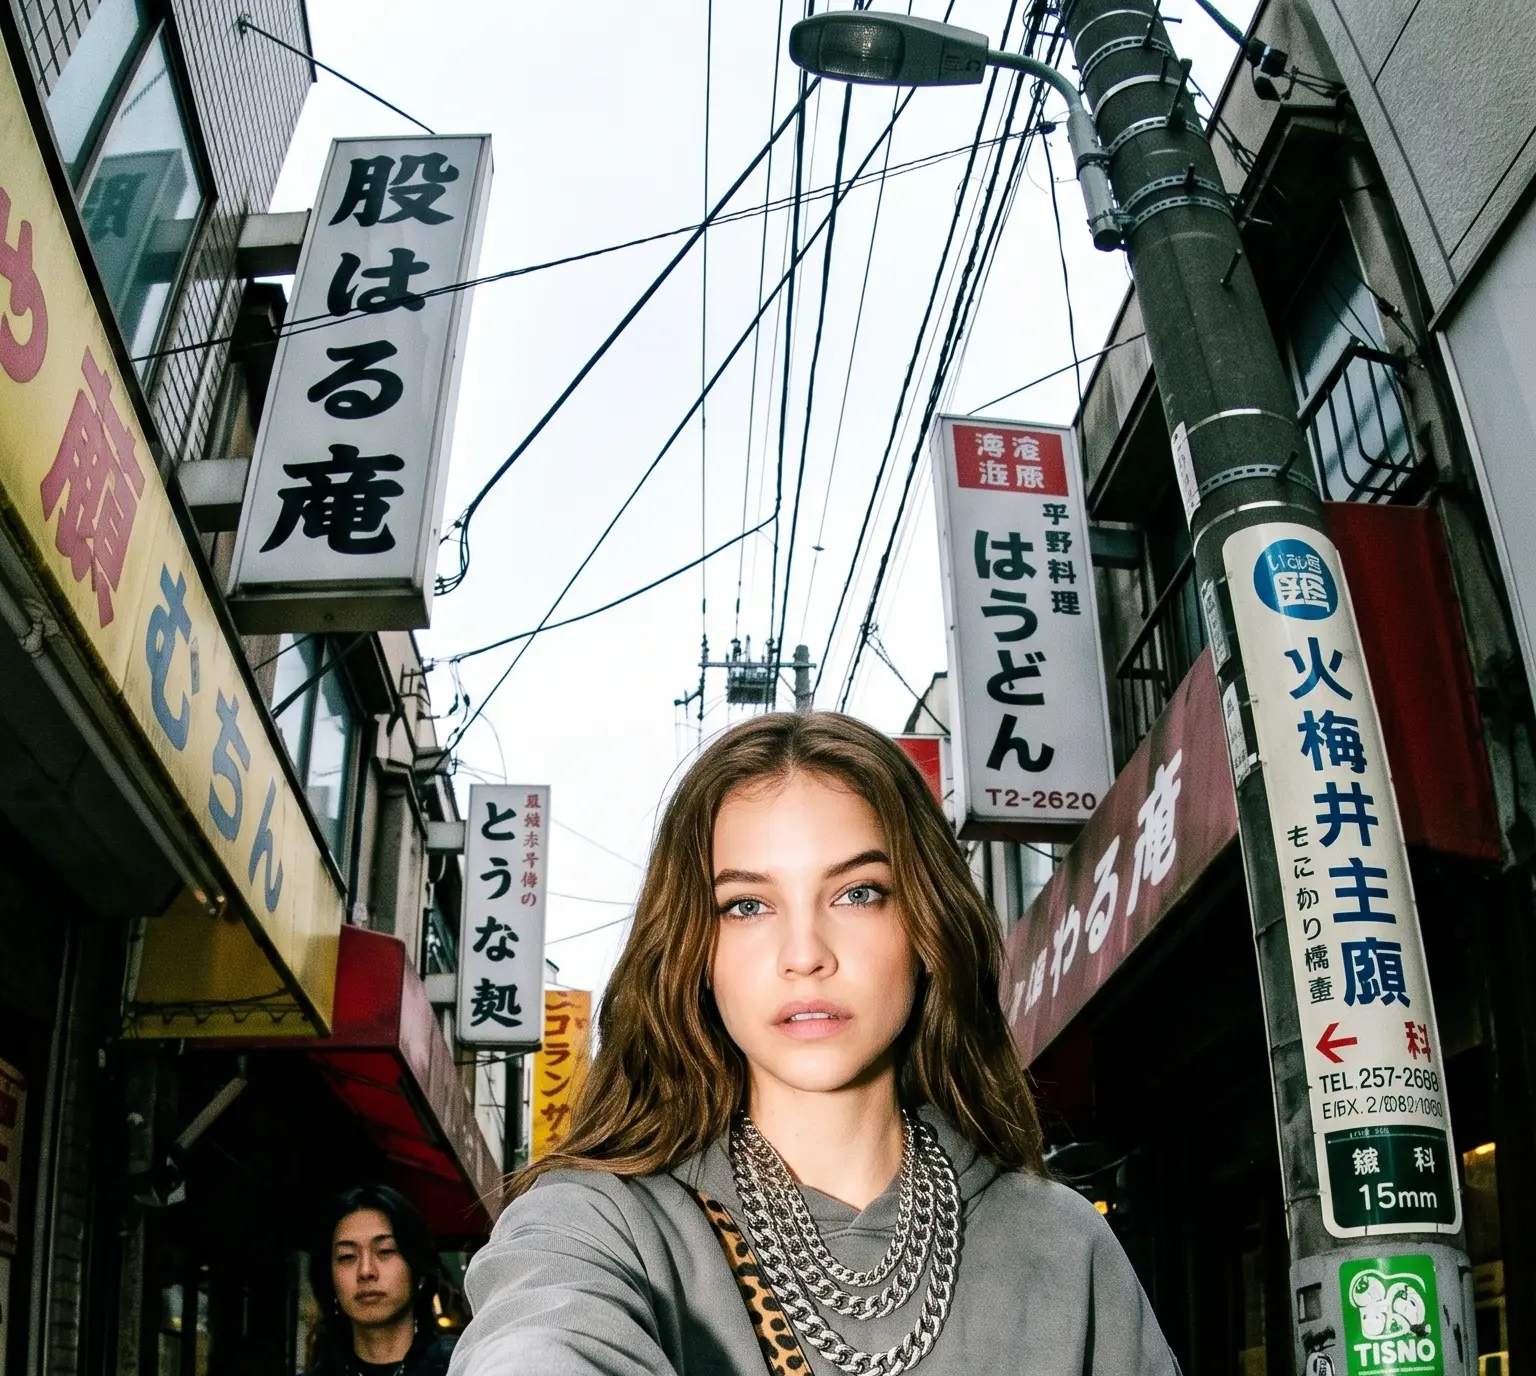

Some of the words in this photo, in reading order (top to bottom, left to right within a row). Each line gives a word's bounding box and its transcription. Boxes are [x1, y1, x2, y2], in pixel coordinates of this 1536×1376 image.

[974, 529, 1055, 773] はうどん
[985, 788, 1097, 810] T2-2620
[1359, 1182, 1437, 1210] 15mm
[1353, 1339, 1436, 1367] TISNO
